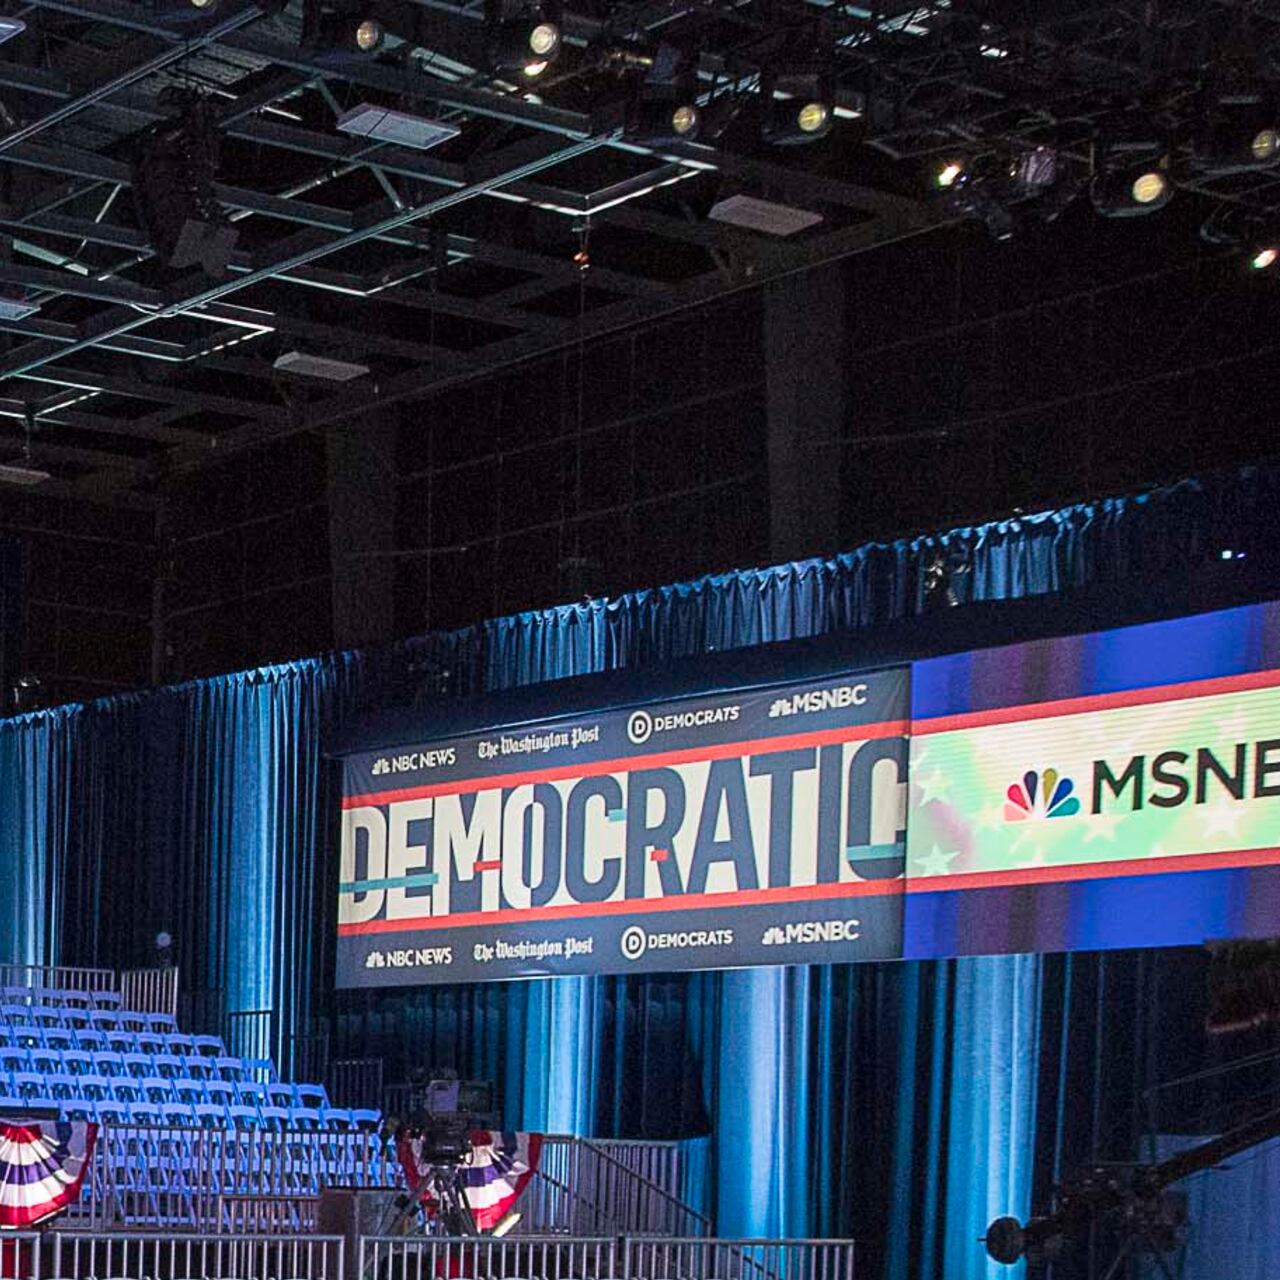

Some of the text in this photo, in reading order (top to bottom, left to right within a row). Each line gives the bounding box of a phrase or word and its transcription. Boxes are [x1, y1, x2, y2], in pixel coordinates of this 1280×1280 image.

[793, 684, 868, 715] MSNBC
[654, 706, 740, 731] DEMOCRATS
[478, 725, 599, 760] The Washington Post
[391, 748, 456, 773] NBC NEWS
[338, 735, 908, 924] DEMOCRATIC
[648, 929, 733, 949] DEMOCRATS
[785, 919, 859, 943] MSNBC
[387, 947, 453, 968] NBC NEWS
[473, 936, 593, 962] The Washington Post
